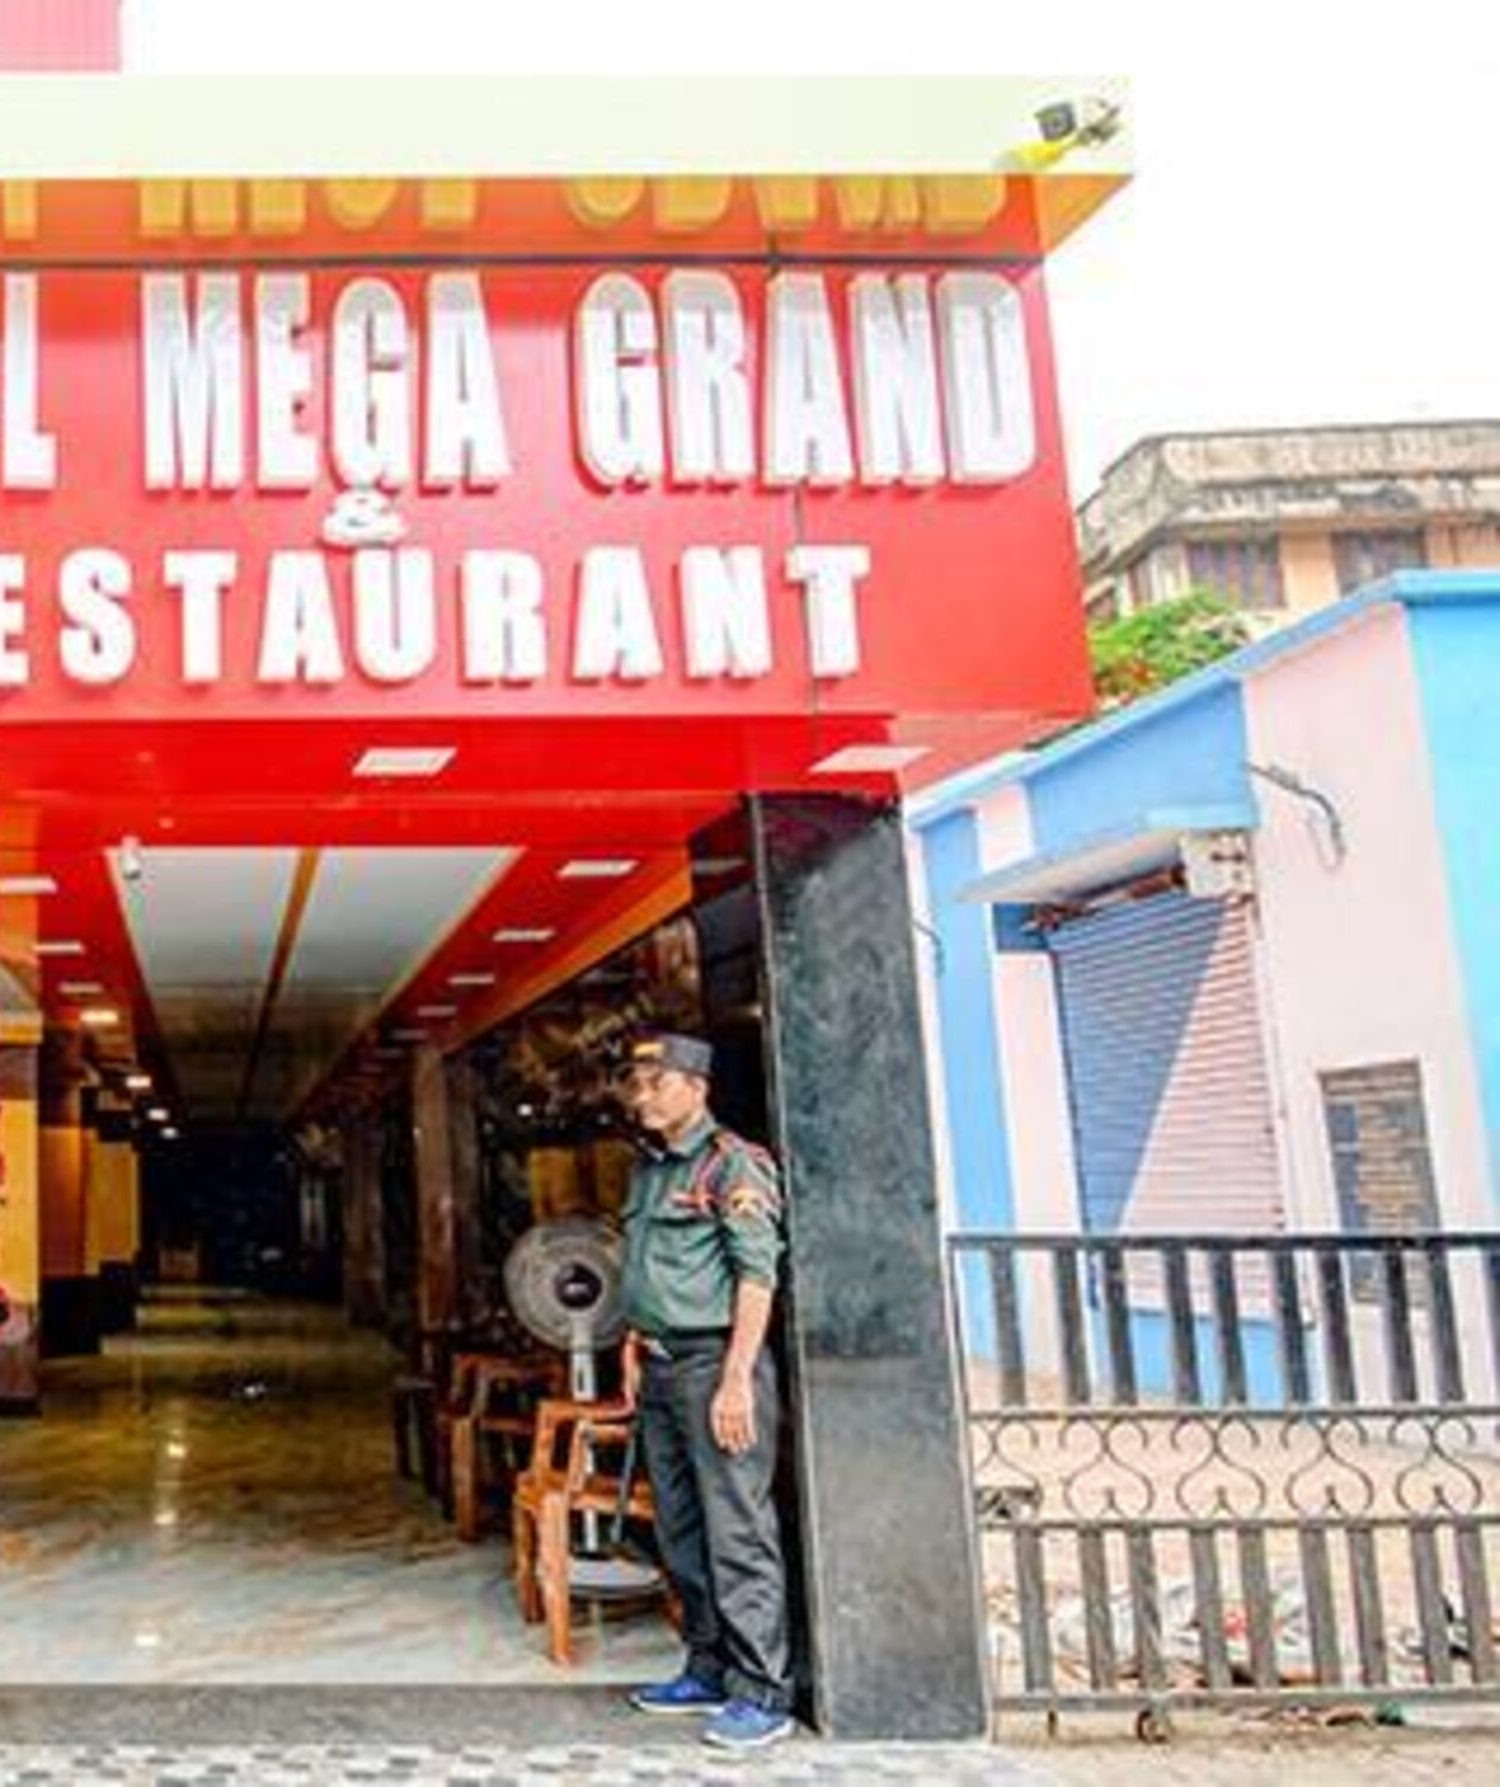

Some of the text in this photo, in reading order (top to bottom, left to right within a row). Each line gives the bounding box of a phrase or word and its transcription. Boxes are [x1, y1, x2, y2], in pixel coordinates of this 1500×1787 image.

[141, 271, 512, 492] MEGA
[573, 268, 1037, 490] GRAND
[320, 488, 408, 548] &
